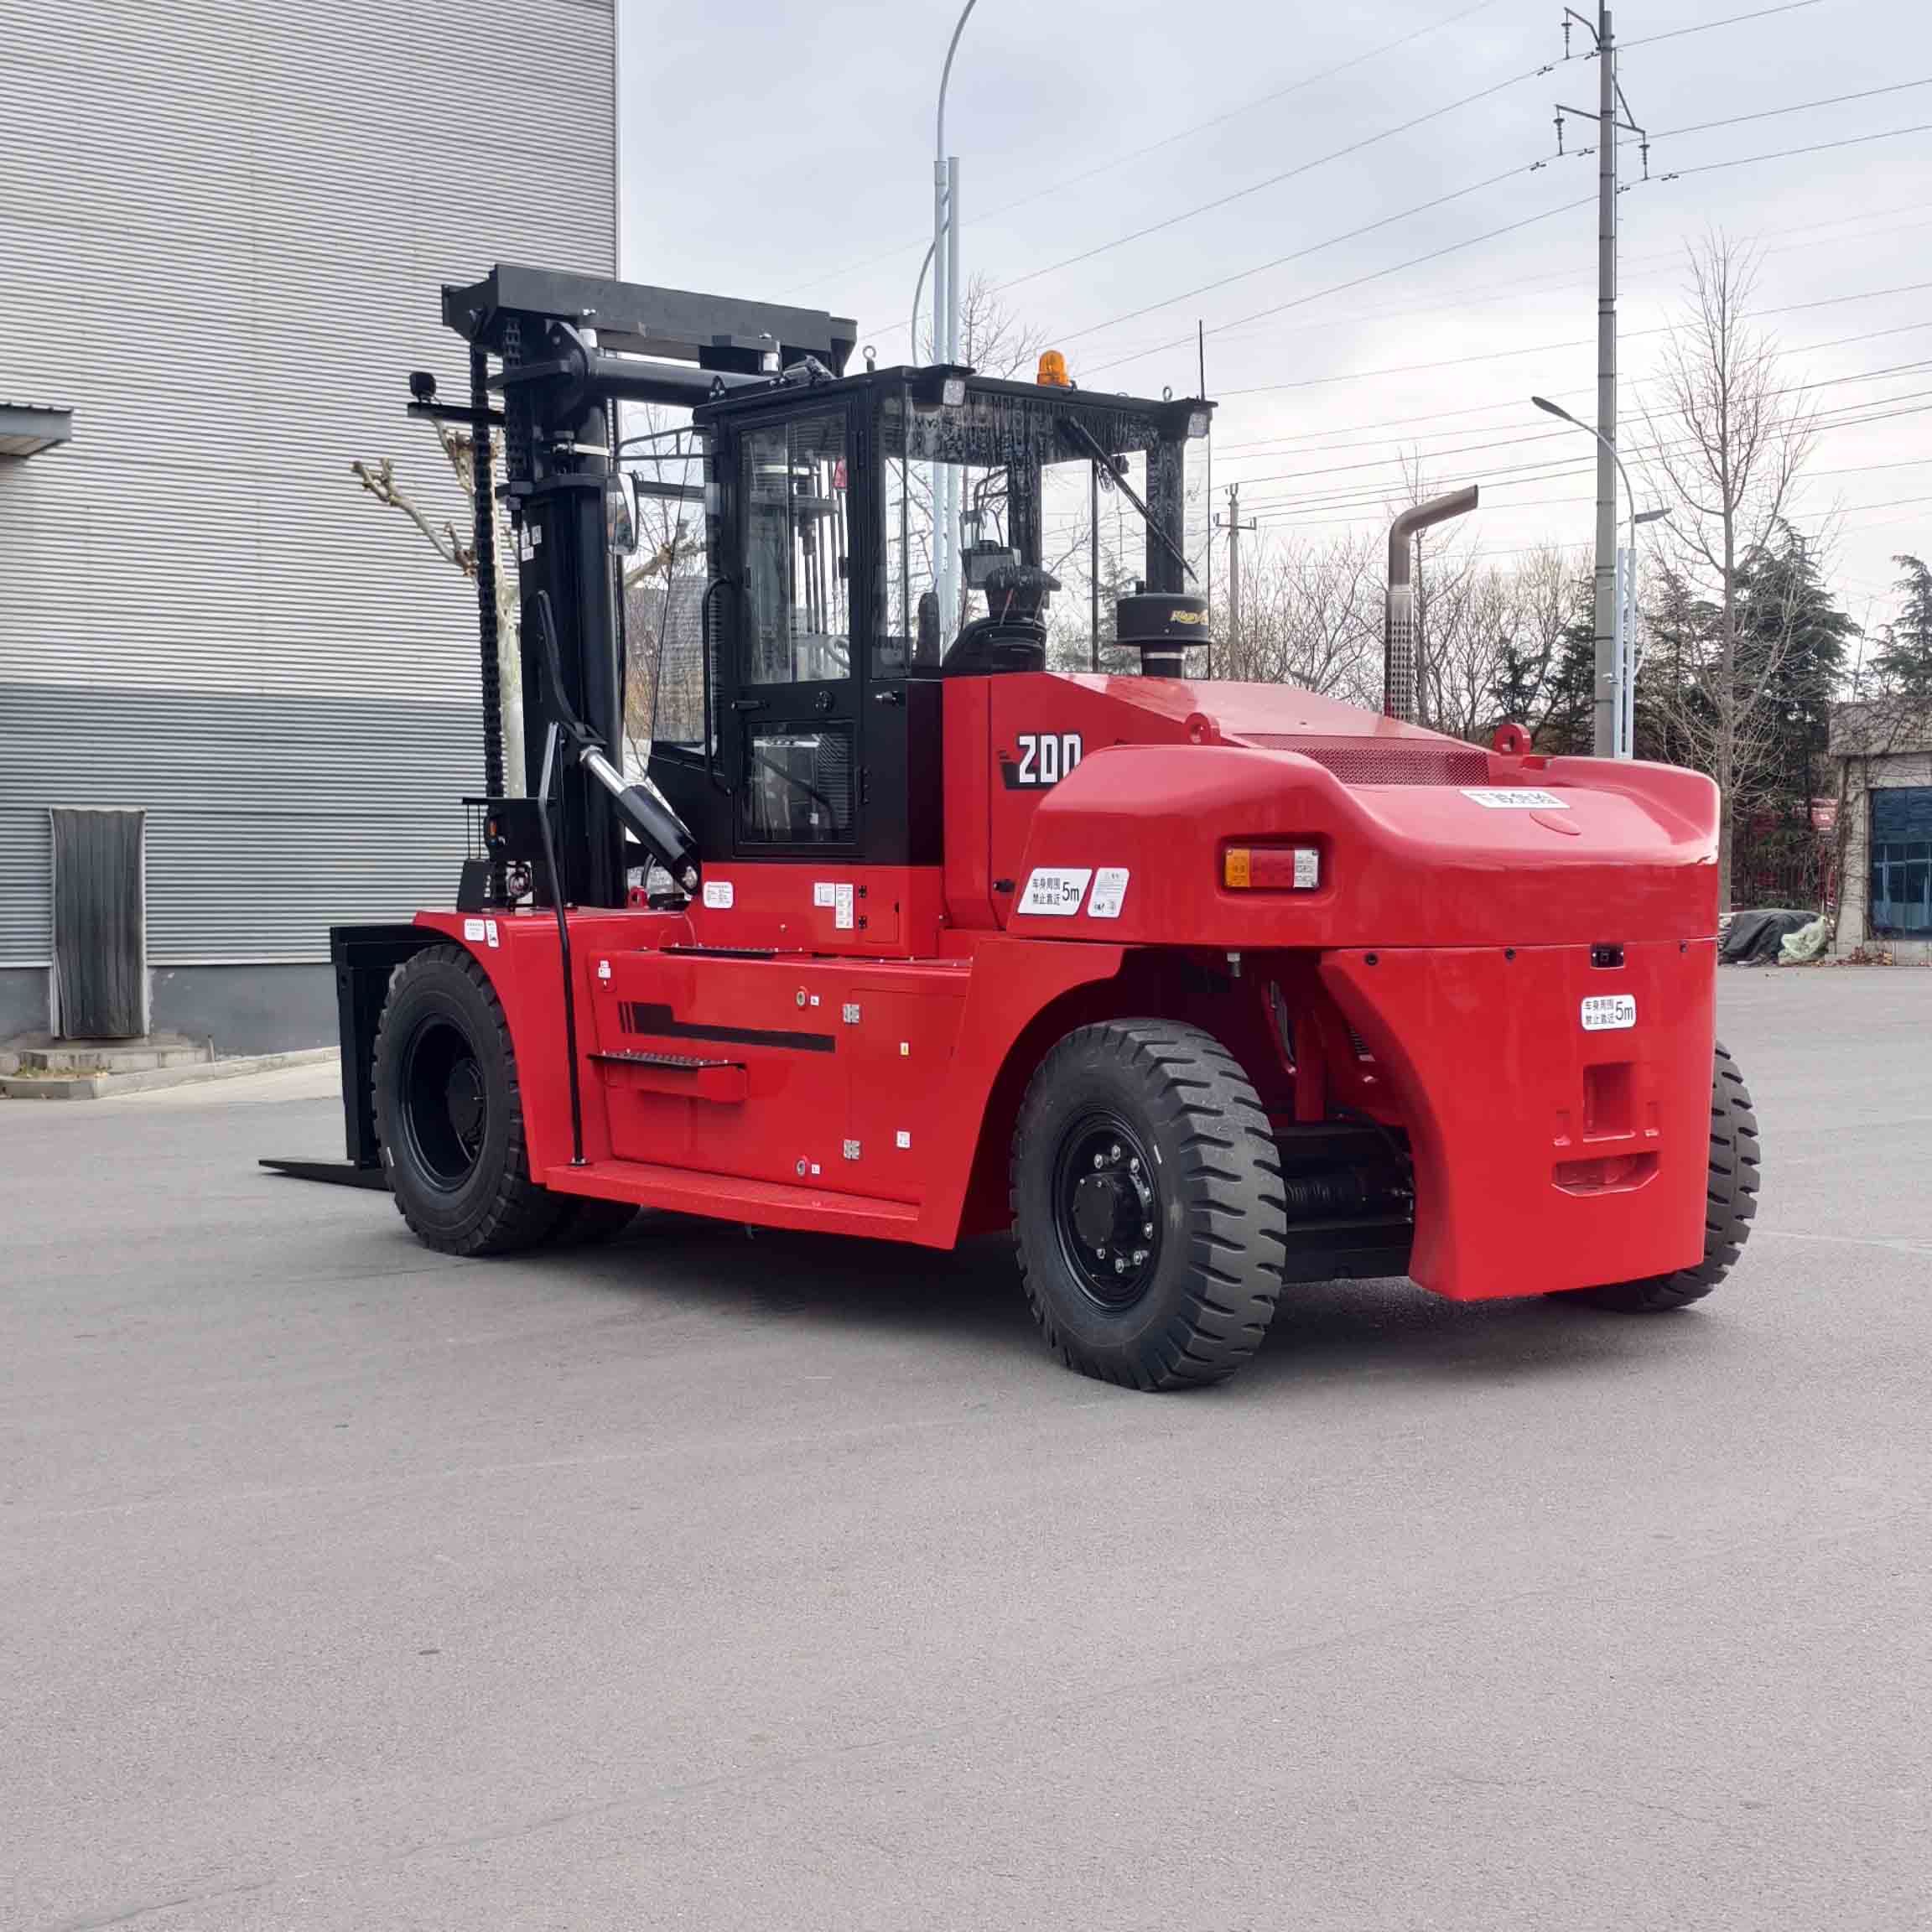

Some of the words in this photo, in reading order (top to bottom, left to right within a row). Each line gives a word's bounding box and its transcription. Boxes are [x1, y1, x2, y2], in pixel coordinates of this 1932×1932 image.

[1019, 735, 1082, 783] 200
[1062, 881, 1080, 902] 5m
[1615, 1000, 1633, 1021] 5m
